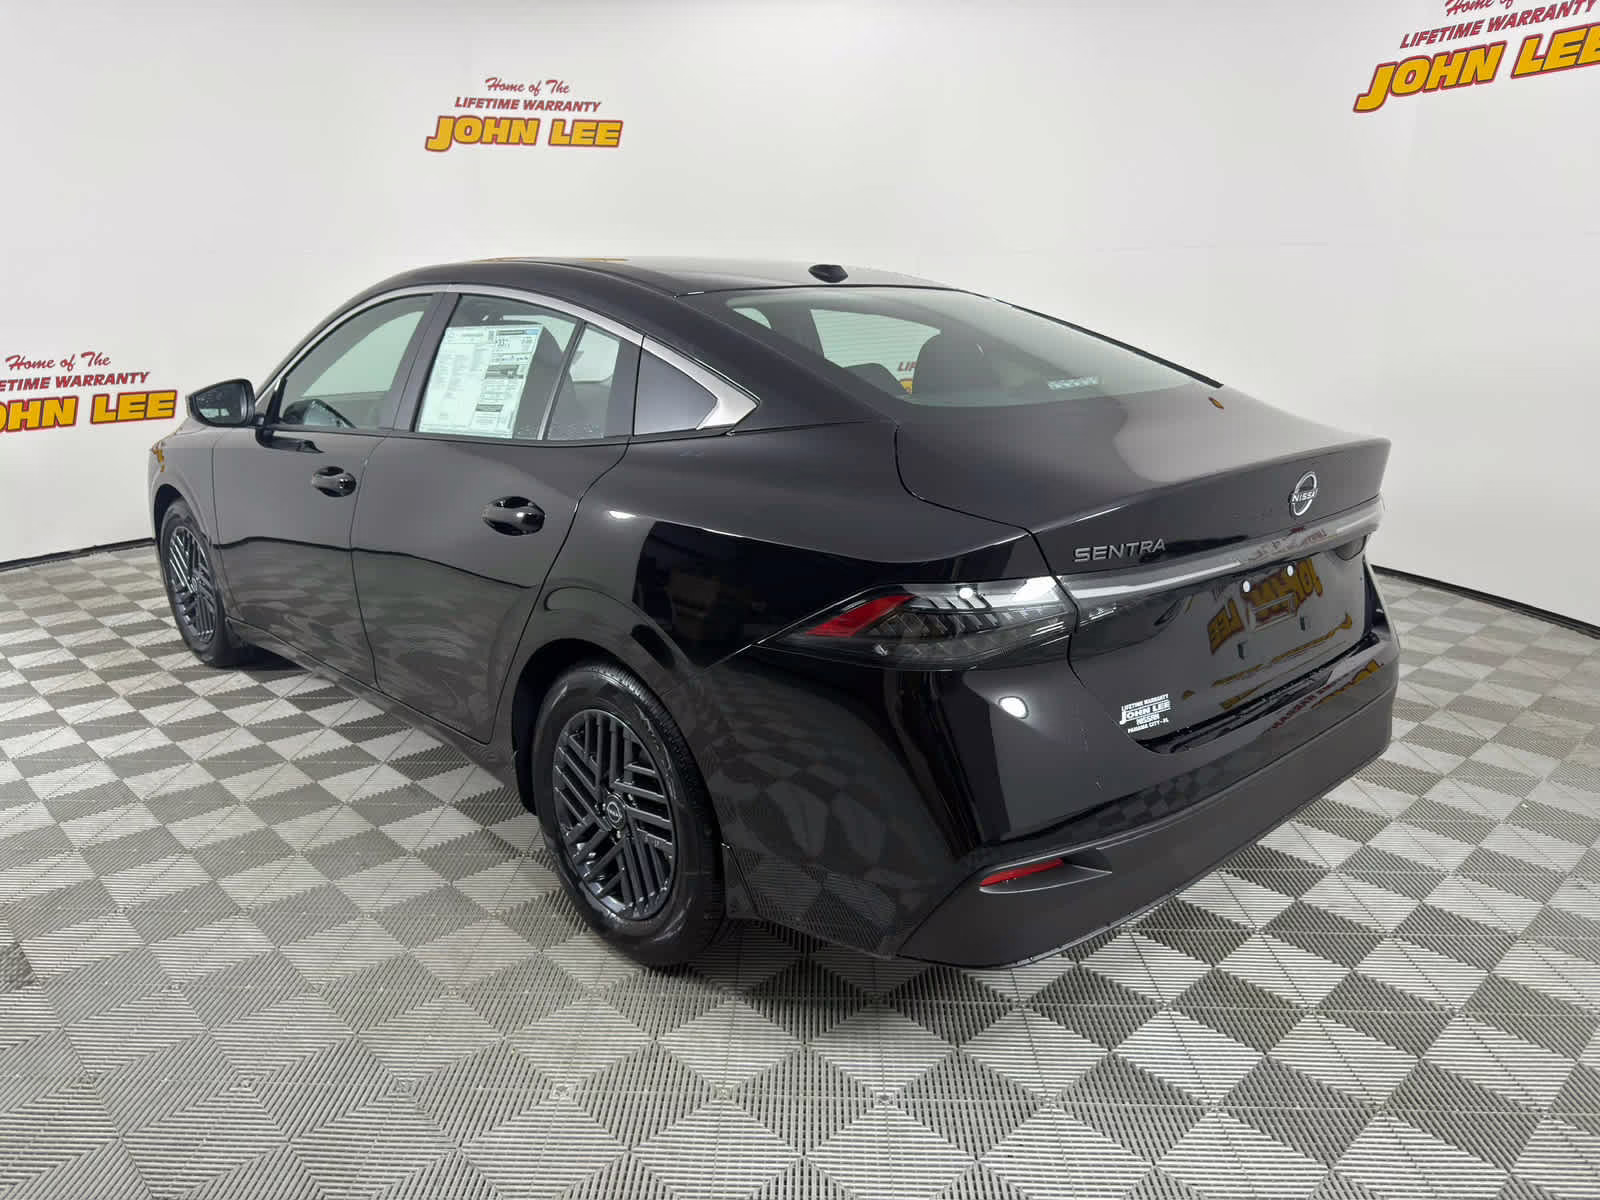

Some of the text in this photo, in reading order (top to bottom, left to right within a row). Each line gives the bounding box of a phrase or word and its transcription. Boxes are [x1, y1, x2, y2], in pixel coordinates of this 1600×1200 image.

[1400, 0, 1600, 48] LIFETIME WARRANTY
[485, 77, 570, 96] Home of The
[1353, 40, 1507, 113] JOHN
[455, 97, 601, 112] LIFETIME WARRANTY
[425, 115, 624, 151] JOHN LEE
[5, 351, 111, 372] Home of The
[55, 372, 151, 388] WARRANTY
[0, 389, 178, 433] HN LEE
[1074, 538, 1166, 562] SENTRA
[1119, 700, 1170, 725] JOHN LEE
